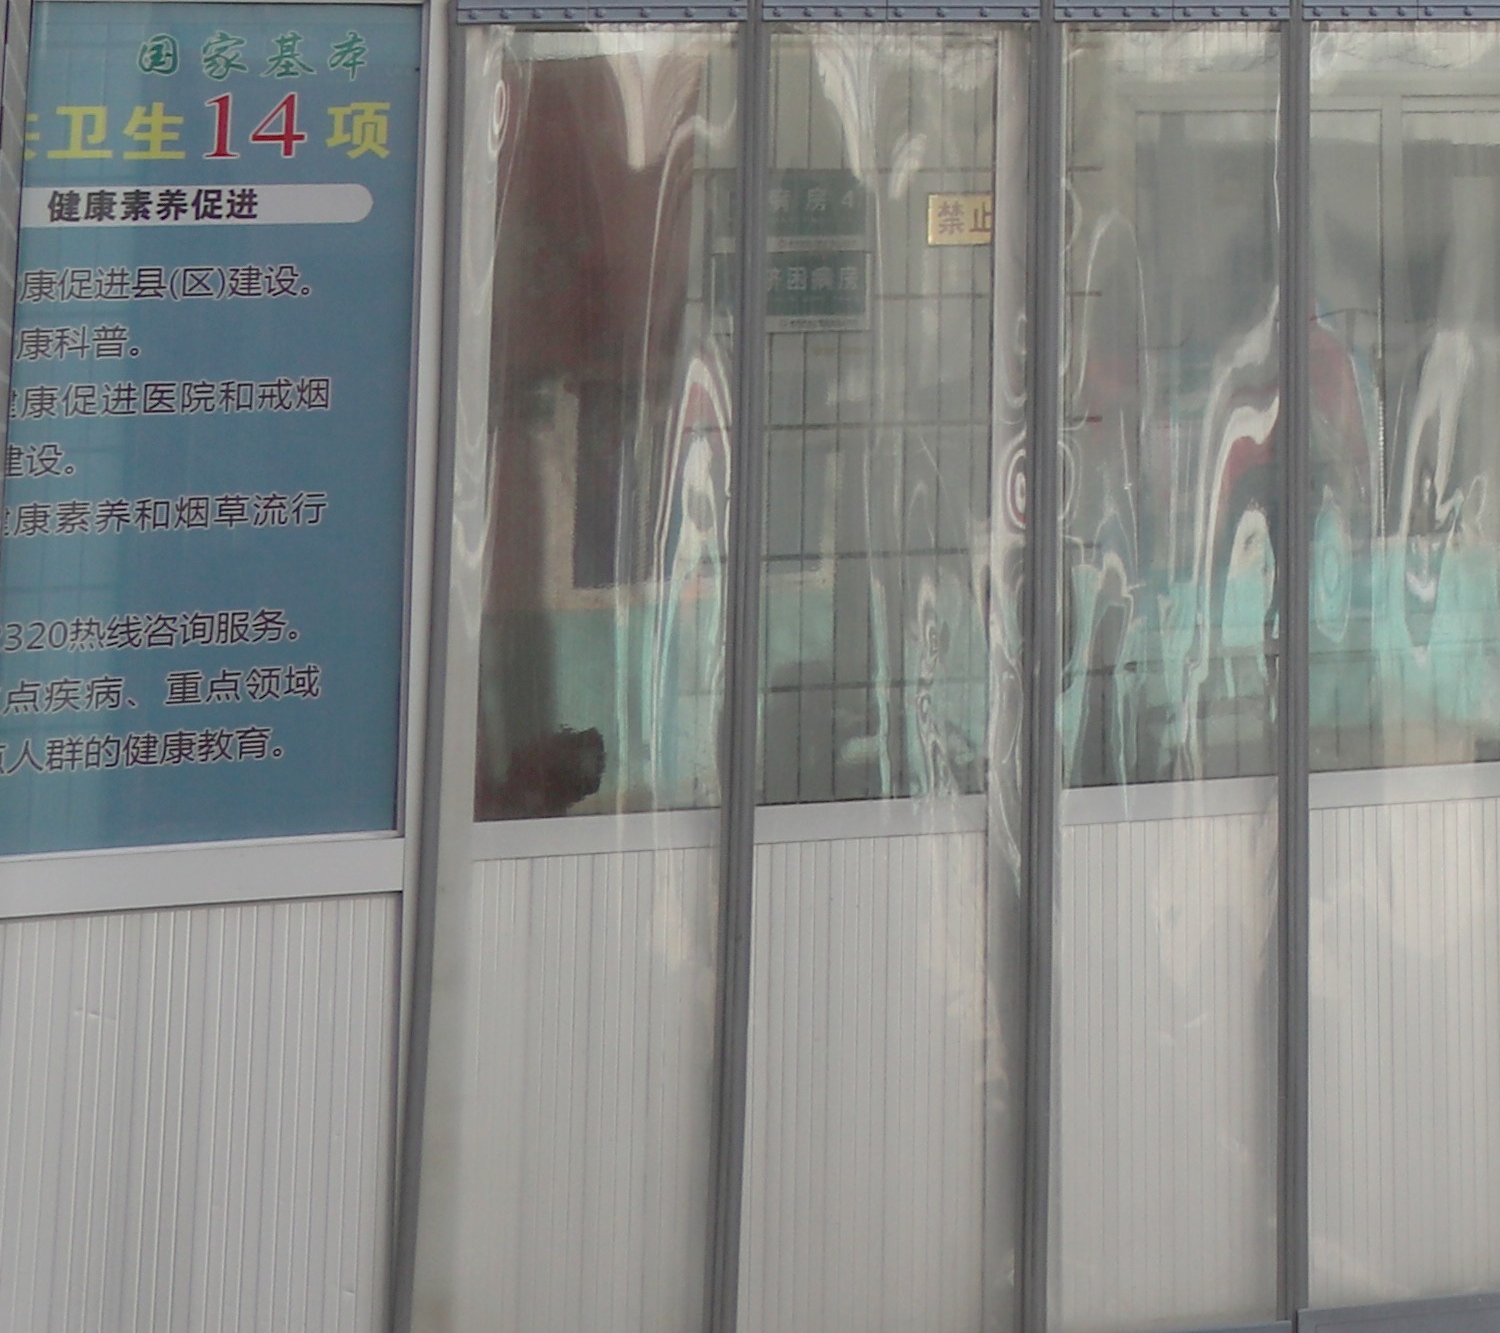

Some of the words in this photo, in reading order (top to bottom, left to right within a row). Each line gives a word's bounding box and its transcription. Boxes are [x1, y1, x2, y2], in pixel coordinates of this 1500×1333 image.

[137, 31, 369, 80] 国家基本
[25, 92, 391, 162] 卫生14项
[48, 187, 258, 223] 健康素养促进
[16, 325, 142, 360] 康科普。
[9, 377, 331, 418] 康促进医院和戒烟
[3, 489, 326, 537] 康素养和烟草流行
[3, 663, 320, 716] 点疾病、重点领域
[0, 727, 284, 774] 人群的健康教育。
